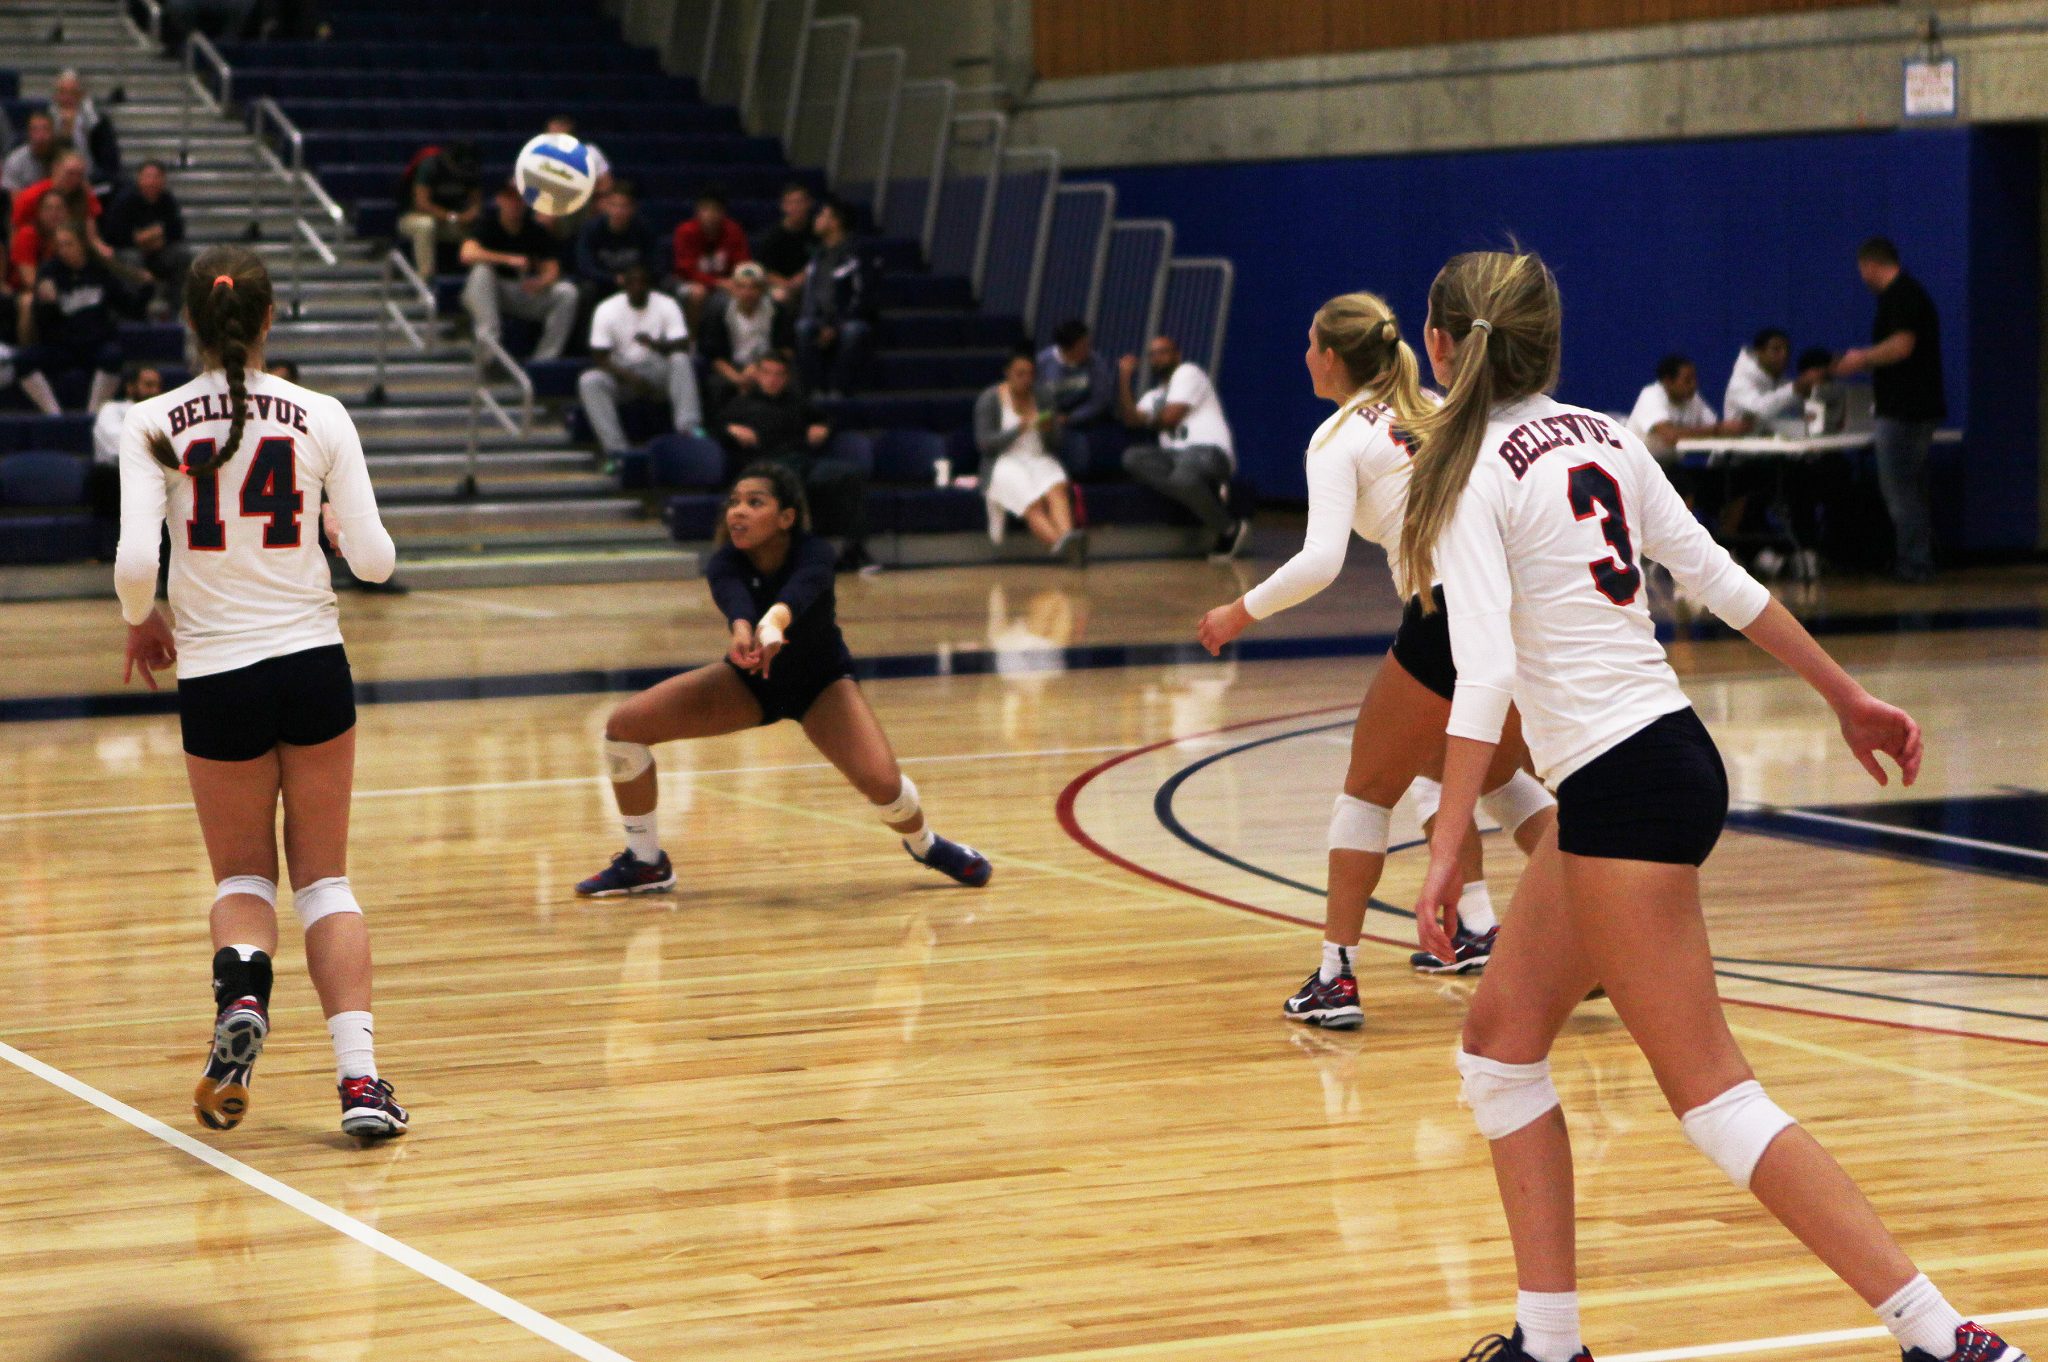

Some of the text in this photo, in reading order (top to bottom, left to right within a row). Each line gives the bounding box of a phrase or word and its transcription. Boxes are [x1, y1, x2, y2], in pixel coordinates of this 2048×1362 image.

[182, 436, 304, 551] 14
[1498, 413, 1623, 481] BELLEVUE
[1566, 461, 1641, 607] 3
